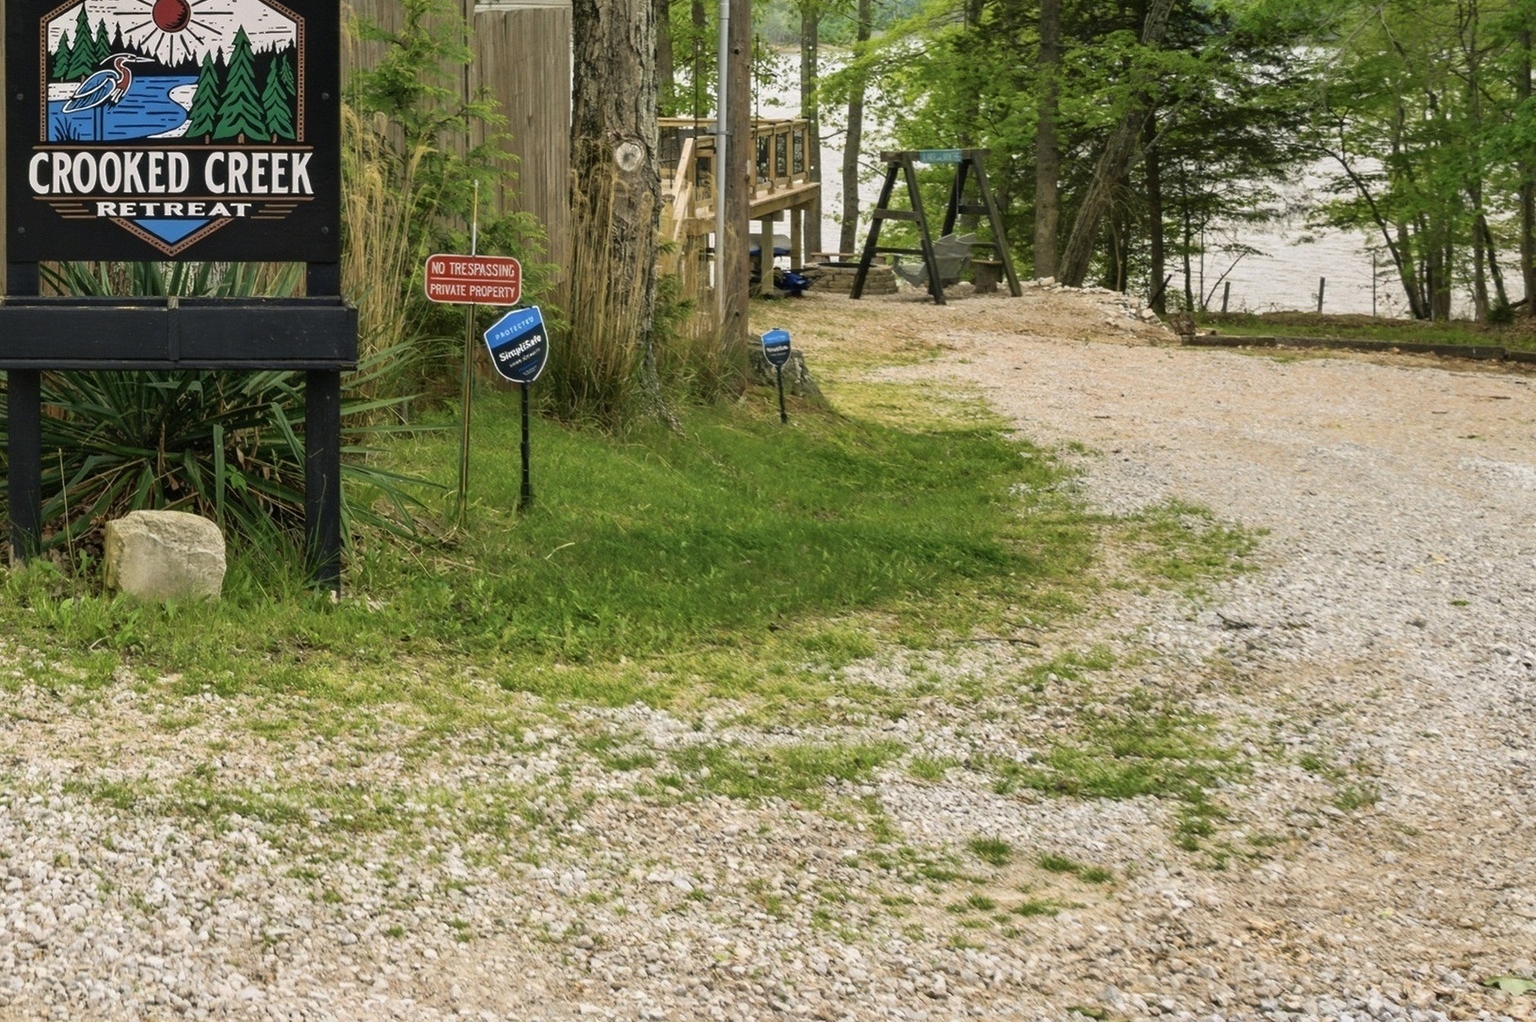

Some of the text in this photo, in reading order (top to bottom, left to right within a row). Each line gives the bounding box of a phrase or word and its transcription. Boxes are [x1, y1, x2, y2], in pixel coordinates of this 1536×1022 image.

[28, 151, 315, 195] CROOKED CREEK
[96, 202, 252, 217] RETREAT
[431, 261, 515, 277] NO TRESPASSING
[430, 283, 515, 298] PRIVATE PROPERTY
[499, 335, 542, 362] SimpliSafe
